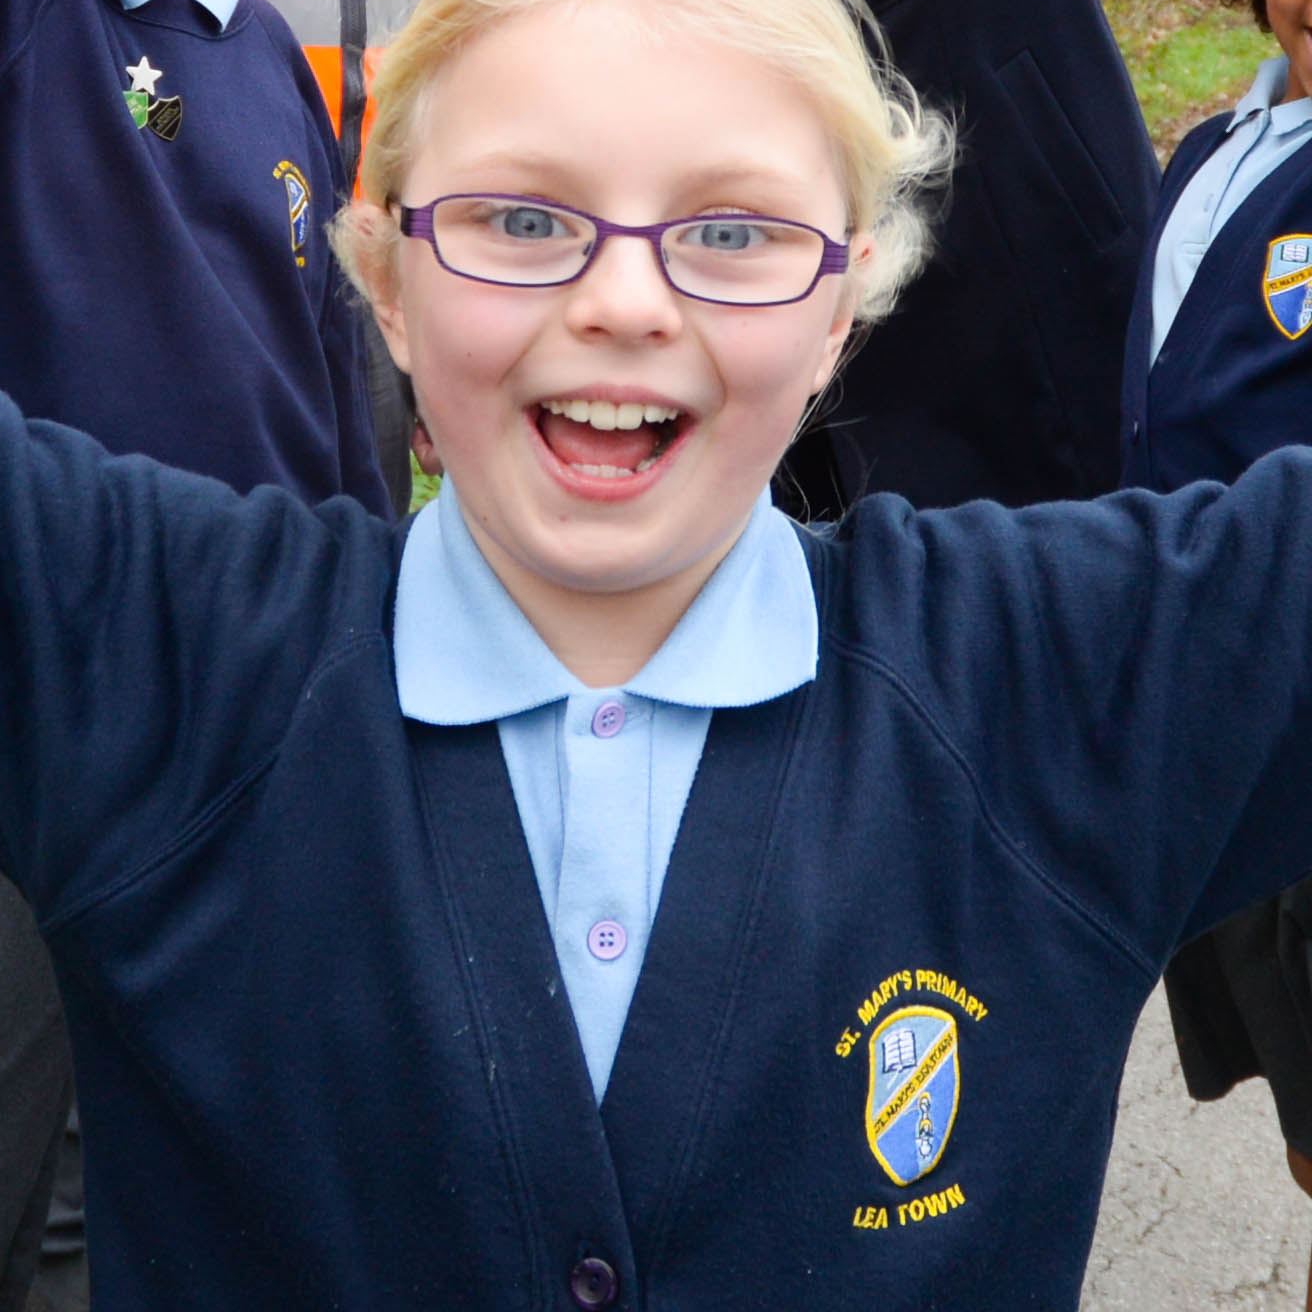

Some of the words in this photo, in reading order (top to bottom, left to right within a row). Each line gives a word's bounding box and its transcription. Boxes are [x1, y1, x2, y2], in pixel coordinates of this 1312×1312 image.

[835, 1027, 861, 1058] ST.
[857, 969, 912, 1026] MARY'S
[916, 969, 988, 1022] PRIMARY
[853, 1206, 888, 1229] LEA
[898, 1184, 966, 1225] TOWN
